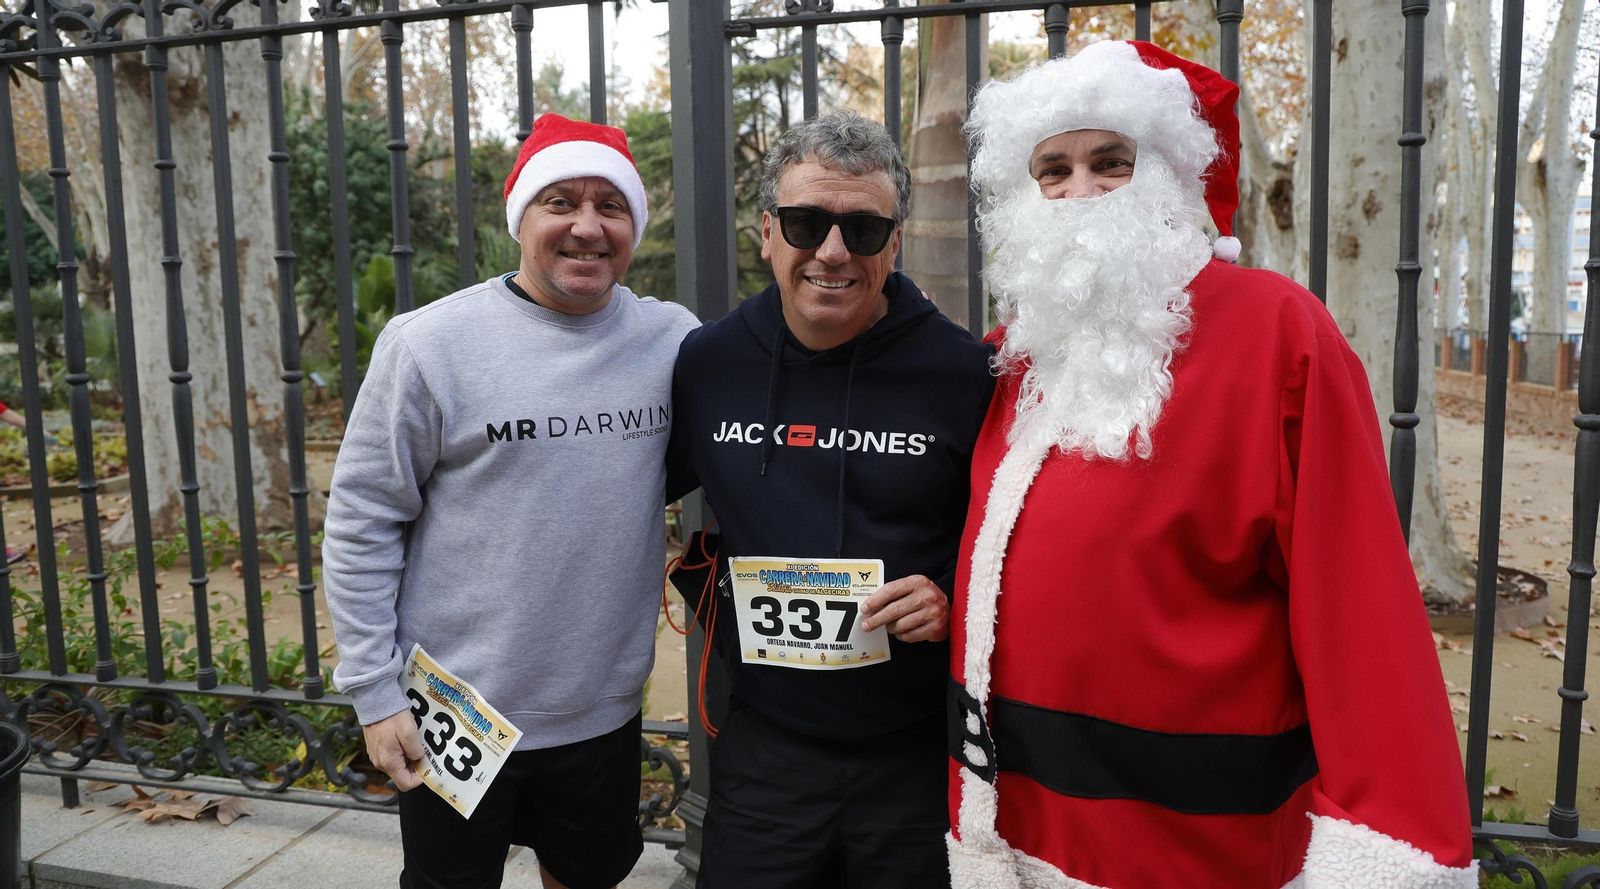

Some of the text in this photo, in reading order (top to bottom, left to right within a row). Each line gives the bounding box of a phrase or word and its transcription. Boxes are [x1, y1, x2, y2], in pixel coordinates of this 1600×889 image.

[486, 403, 669, 443] MR DARWIN
[713, 421, 786, 445] JACK
[623, 429, 653, 441] LIFESTYLE
[794, 563, 819, 572] EDICIÓN
[759, 569, 804, 587] CARRERA
[806, 571, 851, 589] NAVIDAD
[817, 588, 851, 597] ALGECIRAS
[750, 596, 858, 642] 337
[766, 638, 786, 647] ORTEGA
[829, 643, 854, 651] MANUEL
[426, 673, 465, 710] CARRERA
[462, 699, 493, 737] NAVIDAD
